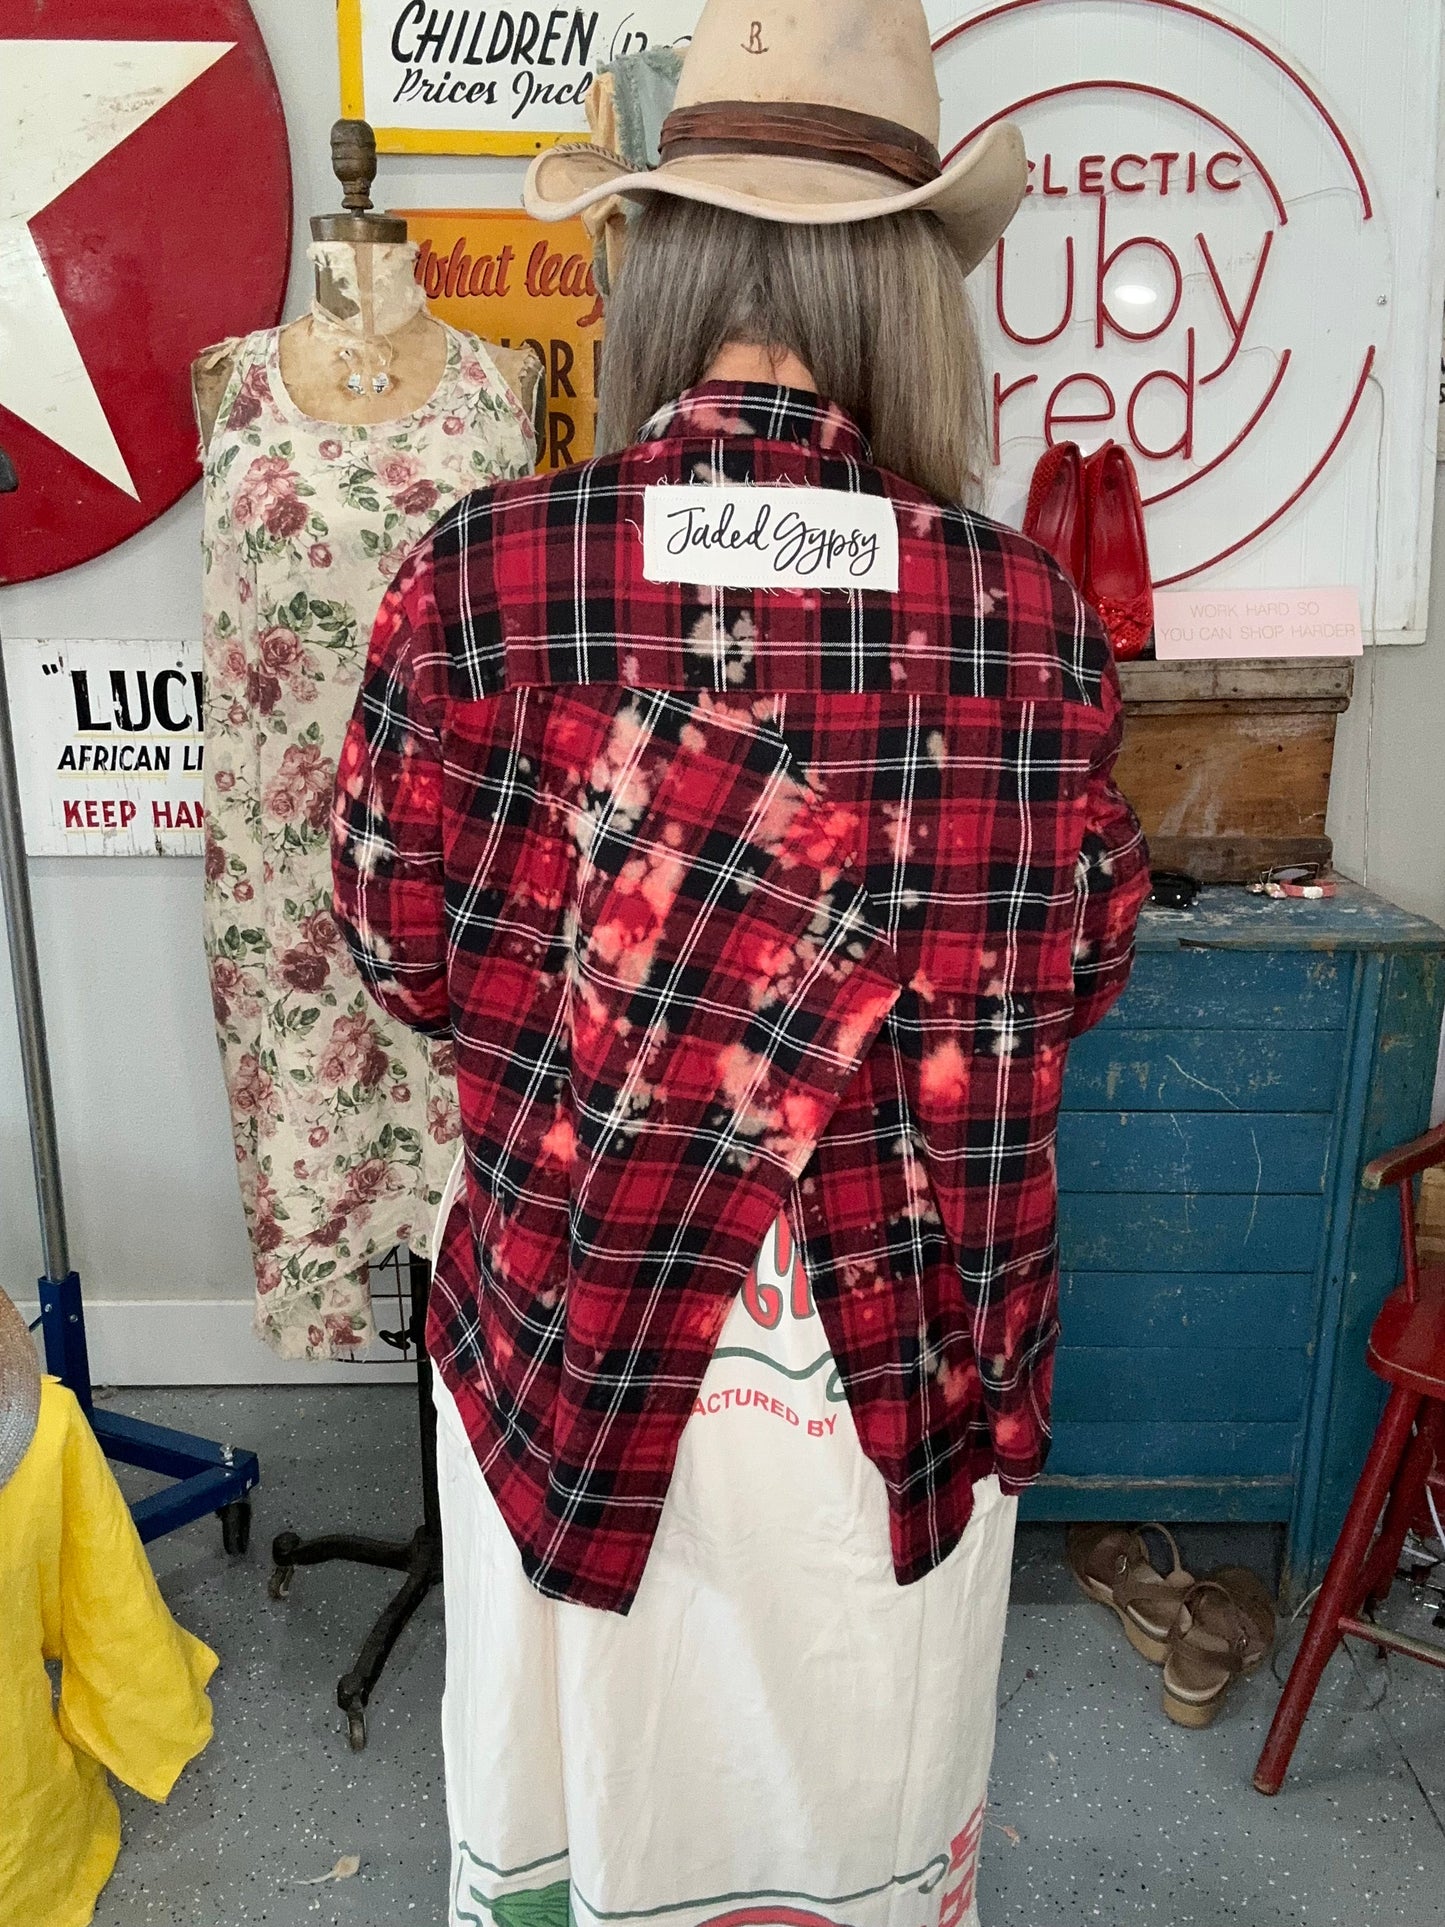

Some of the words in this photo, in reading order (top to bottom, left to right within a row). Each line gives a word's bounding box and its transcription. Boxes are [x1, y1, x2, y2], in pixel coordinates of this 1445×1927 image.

[391, 0, 599, 66] CHILDREN
[393, 68, 498, 104] Prices
[414, 237, 515, 299] What
[993, 327, 1196, 466] red
[666, 503, 771, 555] Jaded
[772, 511, 881, 577] Gypsy
[1190, 604, 1238, 618] WORK
[1246, 603, 1290, 616] HARD
[1297, 601, 1320, 616] SO
[1160, 627, 1194, 642] YOU
[1199, 626, 1232, 641] CAN
[1240, 625, 1285, 640] SHOP
[1291, 623, 1356, 639] HARDER
[57, 745, 171, 772] AFRICAN
[63, 800, 137, 829] KEEP
[807, 1414, 838, 1438] BY
